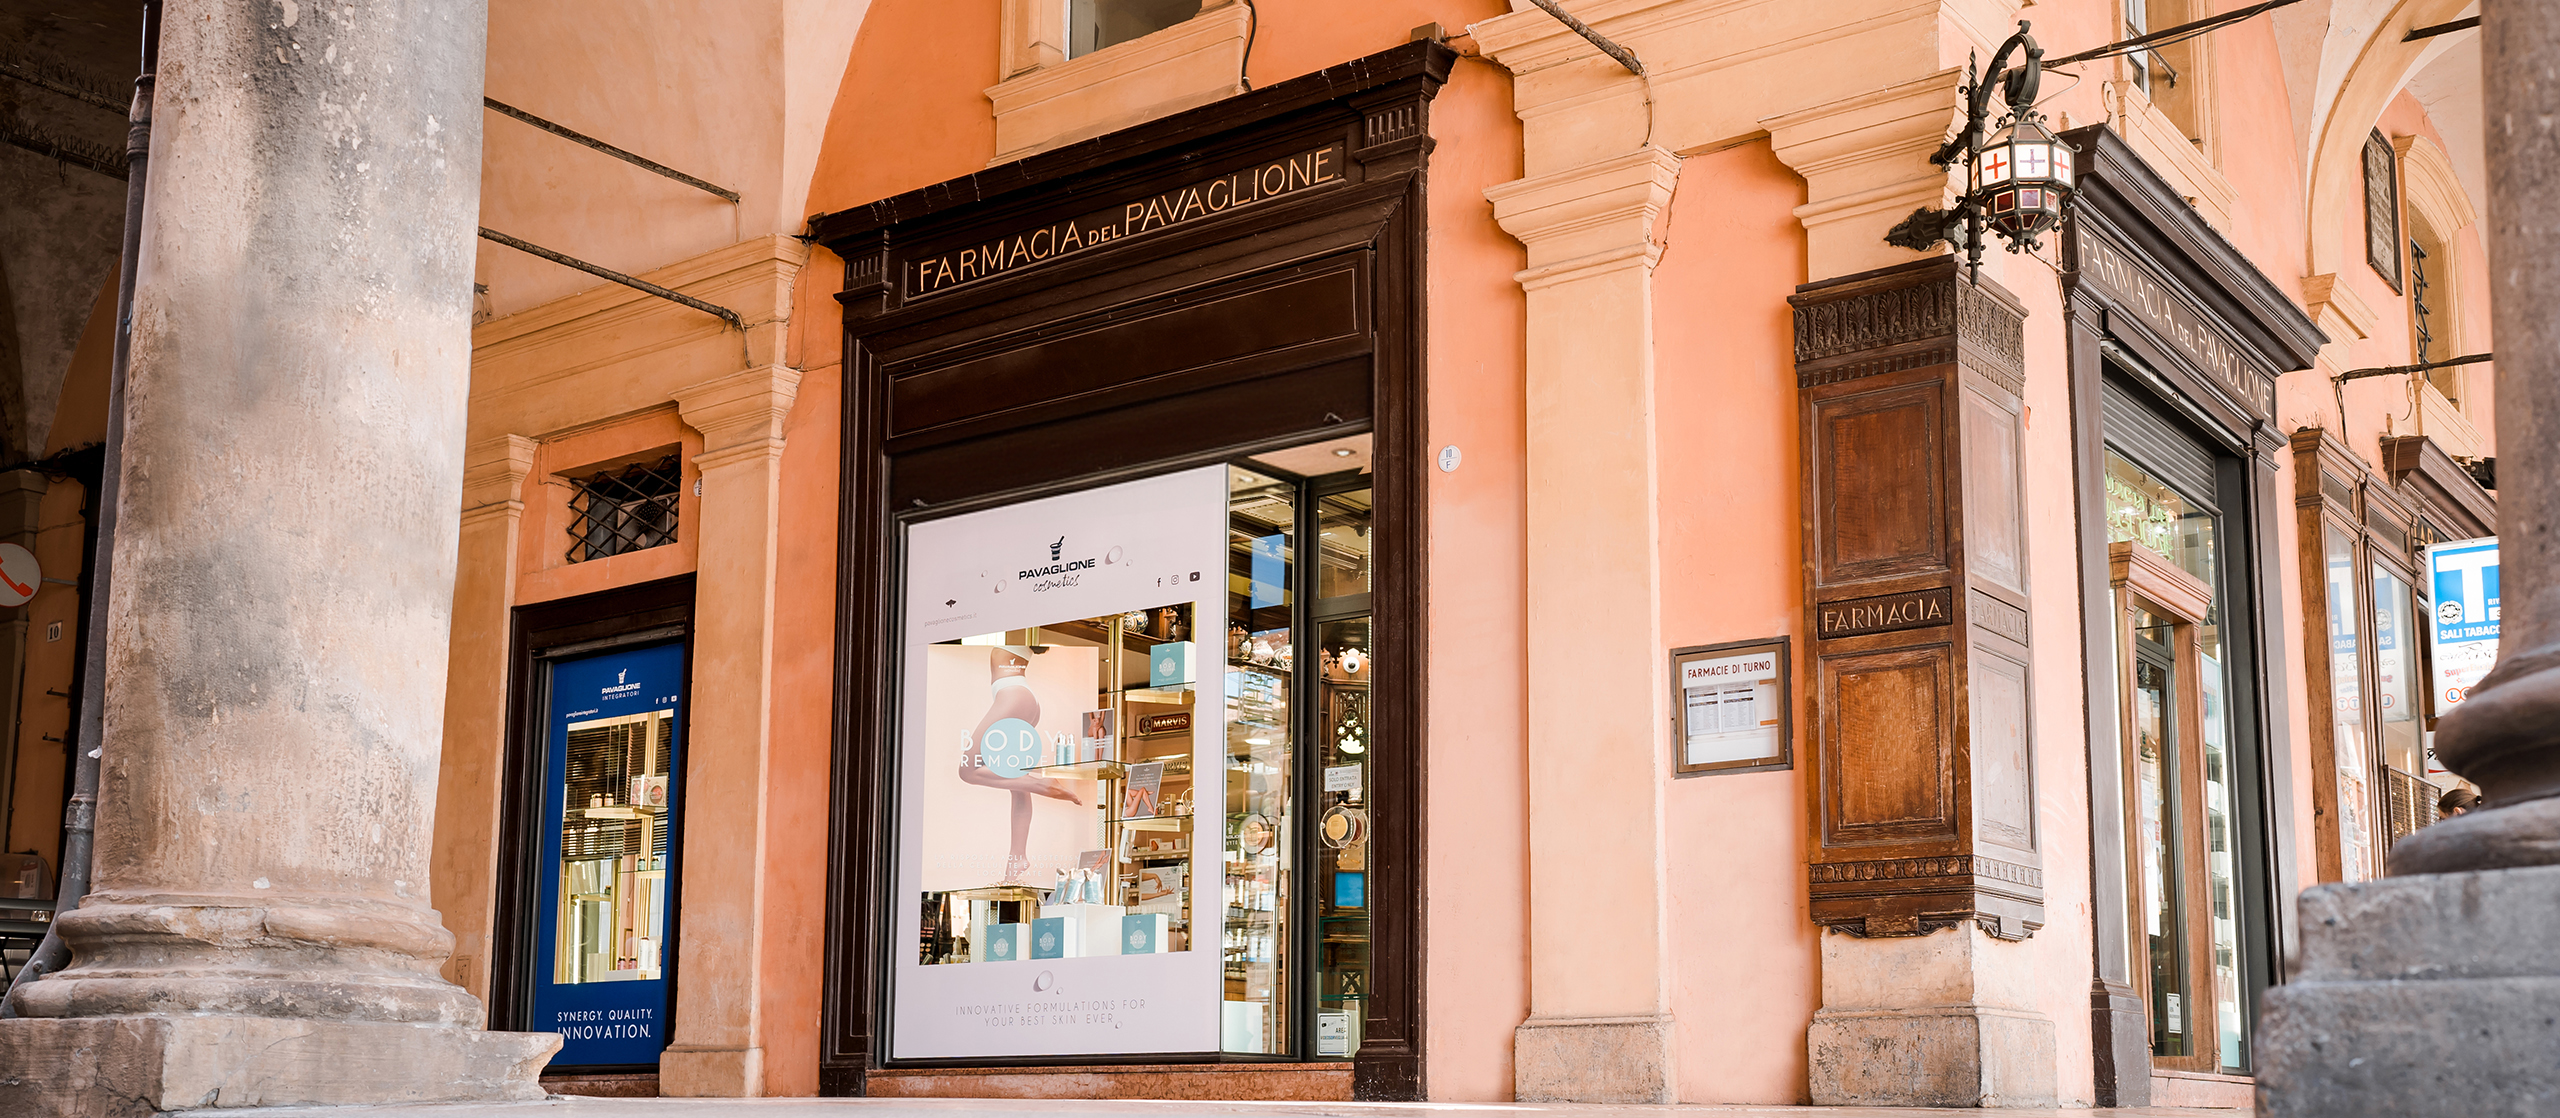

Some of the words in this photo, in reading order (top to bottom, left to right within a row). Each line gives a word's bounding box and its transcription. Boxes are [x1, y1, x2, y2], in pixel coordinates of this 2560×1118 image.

[920, 220, 1083, 292] FARMACIA
[1088, 224, 1121, 246] DEL
[1125, 147, 1335, 235] PAVAGLIONE
[2079, 228, 2176, 336] FARMACIA
[2178, 323, 2197, 353] DEL
[2198, 324, 2273, 418] PAVAGLIONE
[1018, 558, 1096, 581] PAVAGLIONE
[1032, 573, 1080, 593] cosmetics
[1824, 597, 1943, 633] FARMACIA
[1973, 596, 2025, 637] FARMACIA
[49, 625, 59, 640] 10
[2440, 628, 2463, 639] SALI
[1687, 665, 1729, 679] FARMACIE
[1732, 664, 1740, 674] DI
[1743, 660, 1771, 673] TURNO
[601, 682, 641, 694] PAVAGLIONE
[602, 690, 640, 701] INTEGRATORI
[1153, 716, 1187, 729] MARVIS
[960, 728, 1062, 753] BODY
[557, 1010, 603, 1022] SYNERGY.
[608, 1008, 653, 1021] QUALITY.
[955, 1003, 1020, 1016] INNOVATIVE
[1027, 1000, 1116, 1014] FORMULATIONS
[1122, 998, 1146, 1010] FOR
[984, 1016, 1014, 1027] YOUR
[1020, 1015, 1045, 1026] BEST
[1052, 1014, 1077, 1025] SKIN
[1086, 1012, 1113, 1024] EVER
